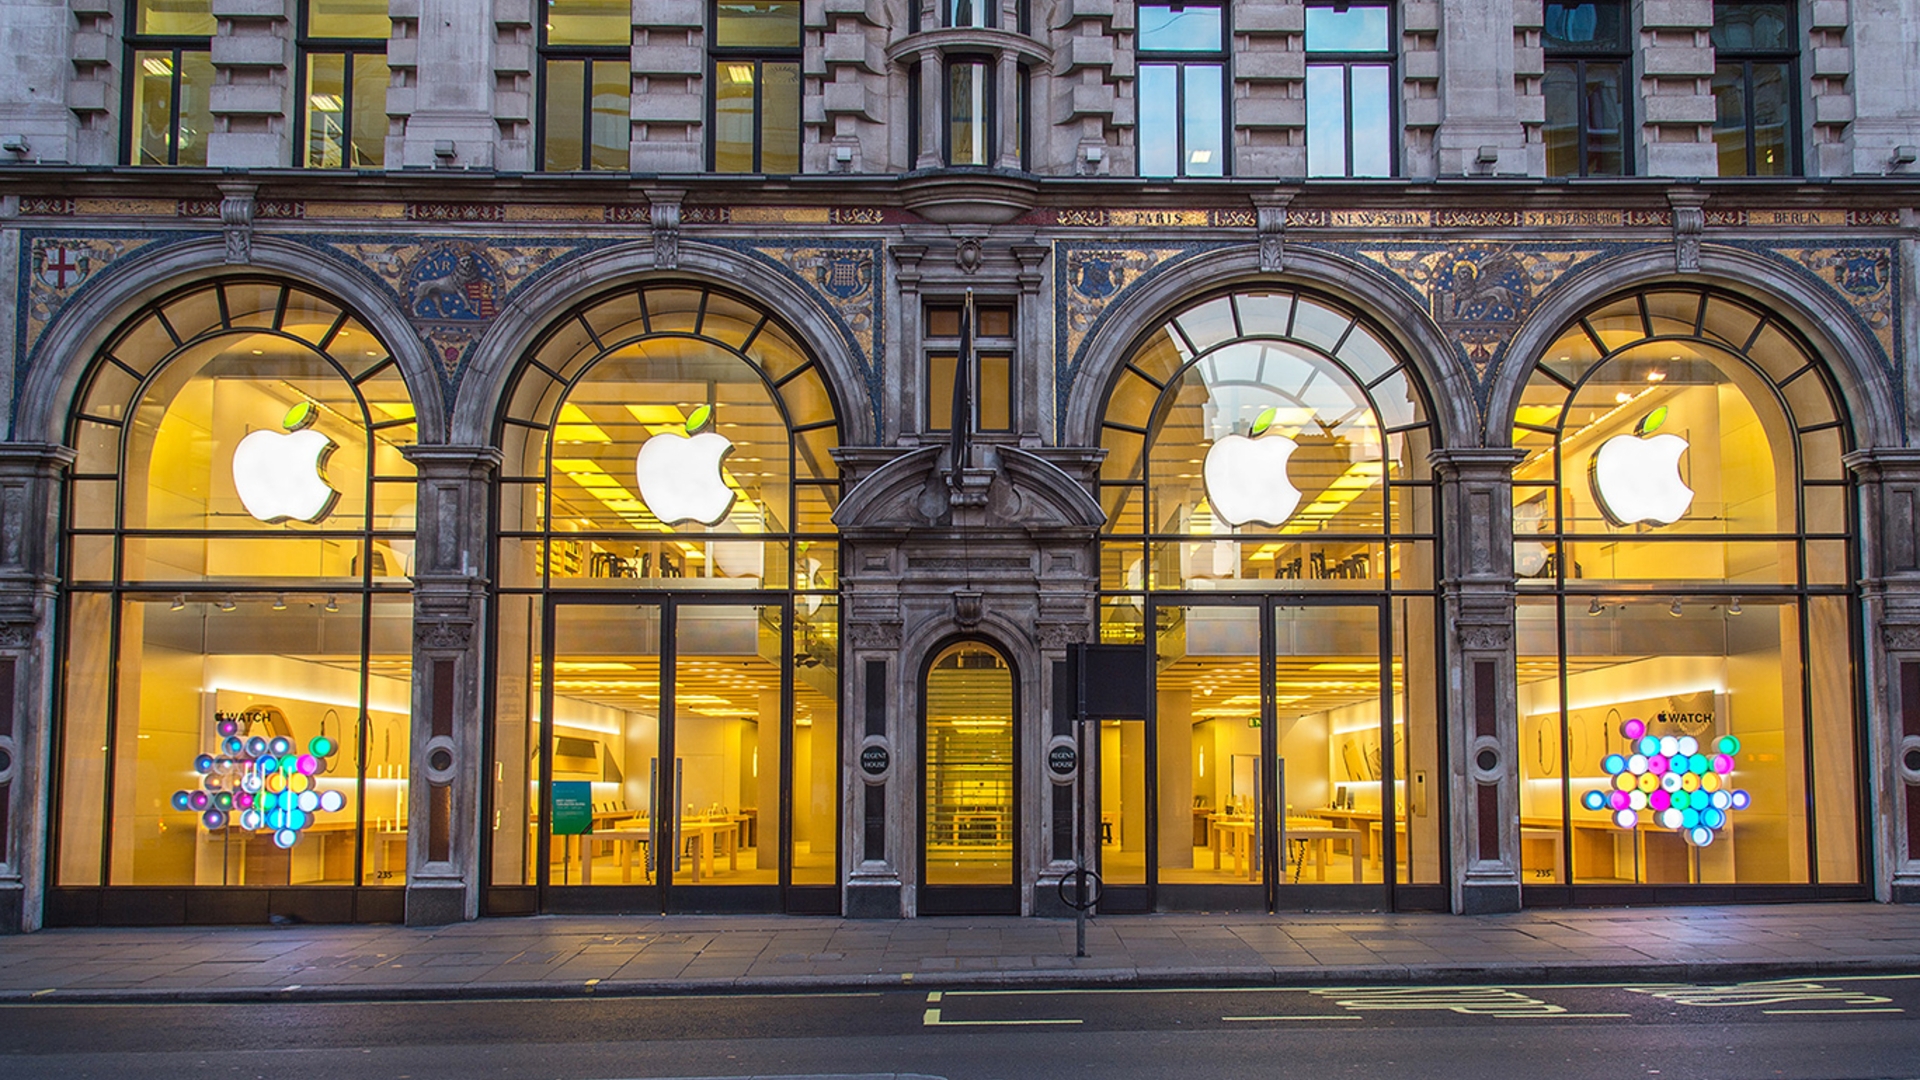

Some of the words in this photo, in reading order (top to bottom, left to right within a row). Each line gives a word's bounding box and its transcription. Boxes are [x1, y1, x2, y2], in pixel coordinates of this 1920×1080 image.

[1135, 212, 1183, 224] PARIS
[1543, 212, 1617, 225] PETERSBURG
[1773, 212, 1820, 224] BERLIN
[226, 712, 271, 722] WATCH
[1668, 713, 1712, 723] WATCH
[863, 752, 887, 760] REGENT
[1050, 752, 1074, 760] REGENT
[377, 871, 392, 879] 235
[1535, 870, 1550, 878] 235
